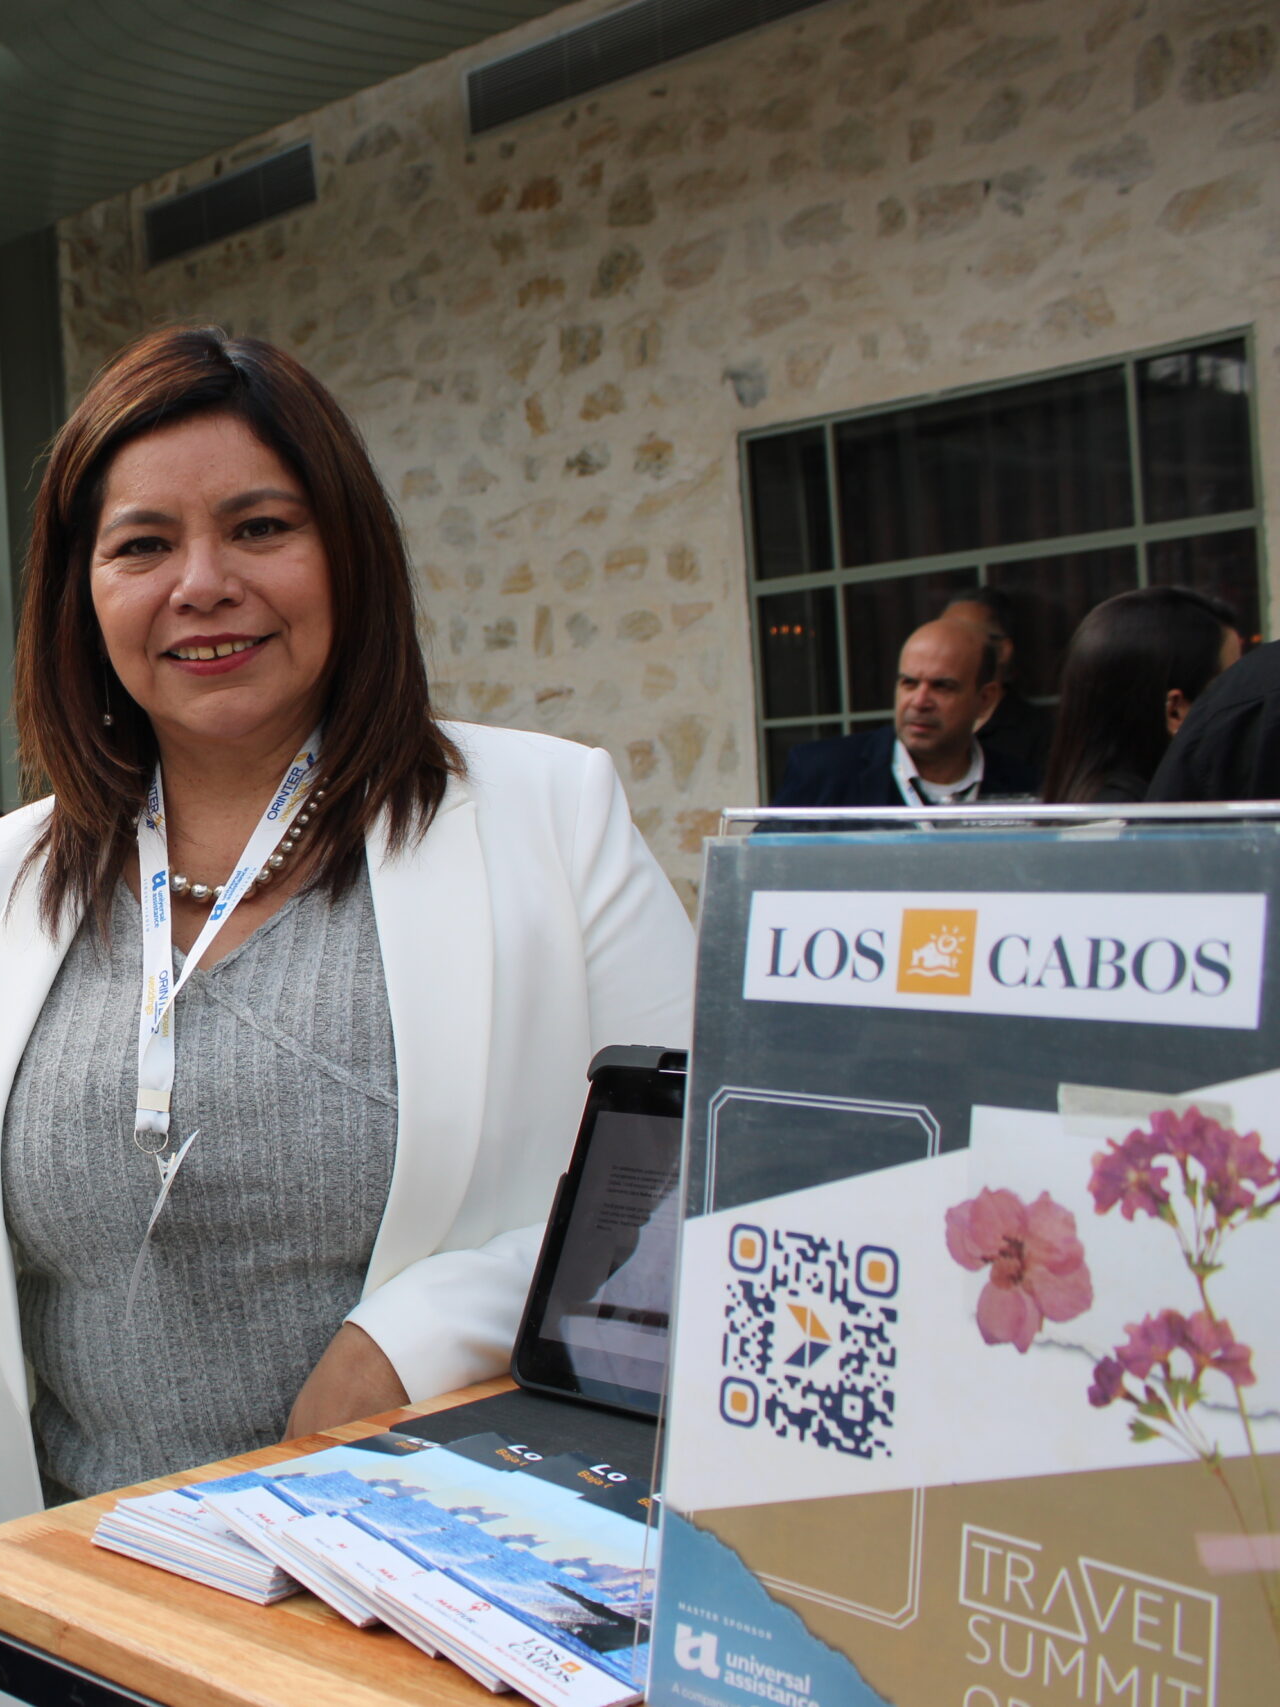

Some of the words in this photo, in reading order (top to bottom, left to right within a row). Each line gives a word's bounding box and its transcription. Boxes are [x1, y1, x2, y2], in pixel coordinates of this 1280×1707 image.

[266, 765, 304, 823] ORINTER
[158, 890, 166, 922] universal
[765, 927, 886, 982] LOS
[988, 934, 1233, 997] CABOS
[678, 1601, 719, 1622] MASTER
[723, 1616, 772, 1640] SPONSOR
[971, 1541, 1204, 1665] TRAVEL
[508, 1642, 574, 1683] CABOS
[523, 1638, 564, 1662] LOS
[724, 1669, 820, 1707] assistance
[725, 1652, 811, 1695] universal
